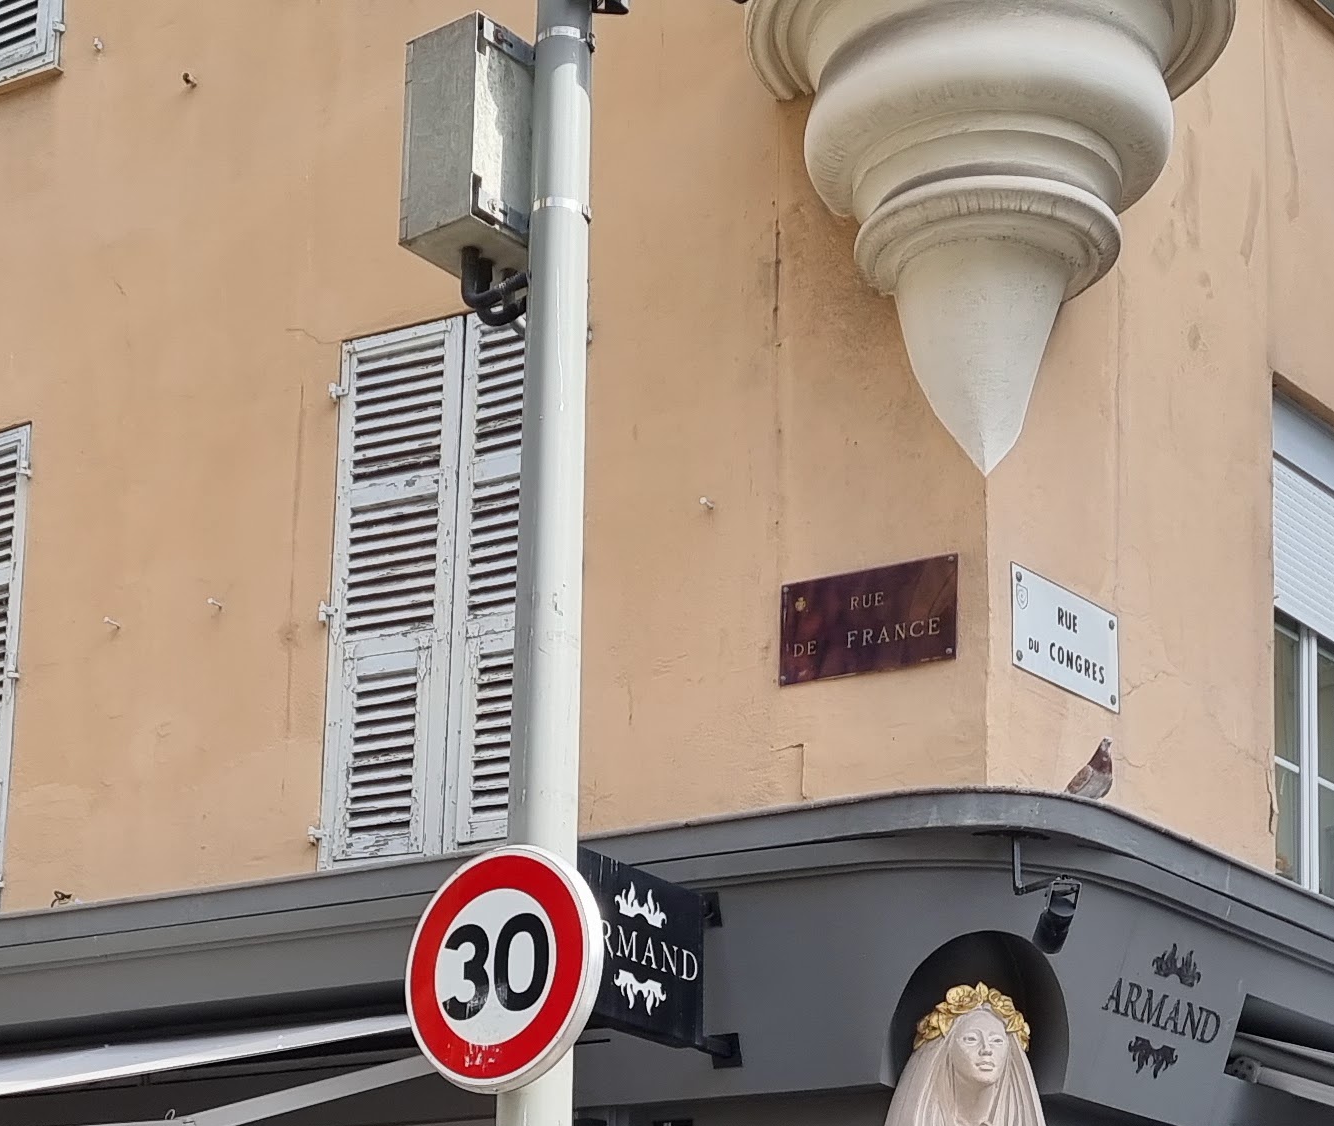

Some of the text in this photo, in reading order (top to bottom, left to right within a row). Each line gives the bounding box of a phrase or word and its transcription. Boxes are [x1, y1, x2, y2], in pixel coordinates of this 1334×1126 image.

[850, 592, 885, 611] RUE
[1057, 606, 1078, 634] RUE
[792, 617, 941, 658] DE FRANCE
[1028, 637, 1105, 685] DU CONGRES
[442, 912, 549, 1021] 30
[601, 919, 698, 981] RMAND
[1102, 976, 1222, 1045] ARMAND
